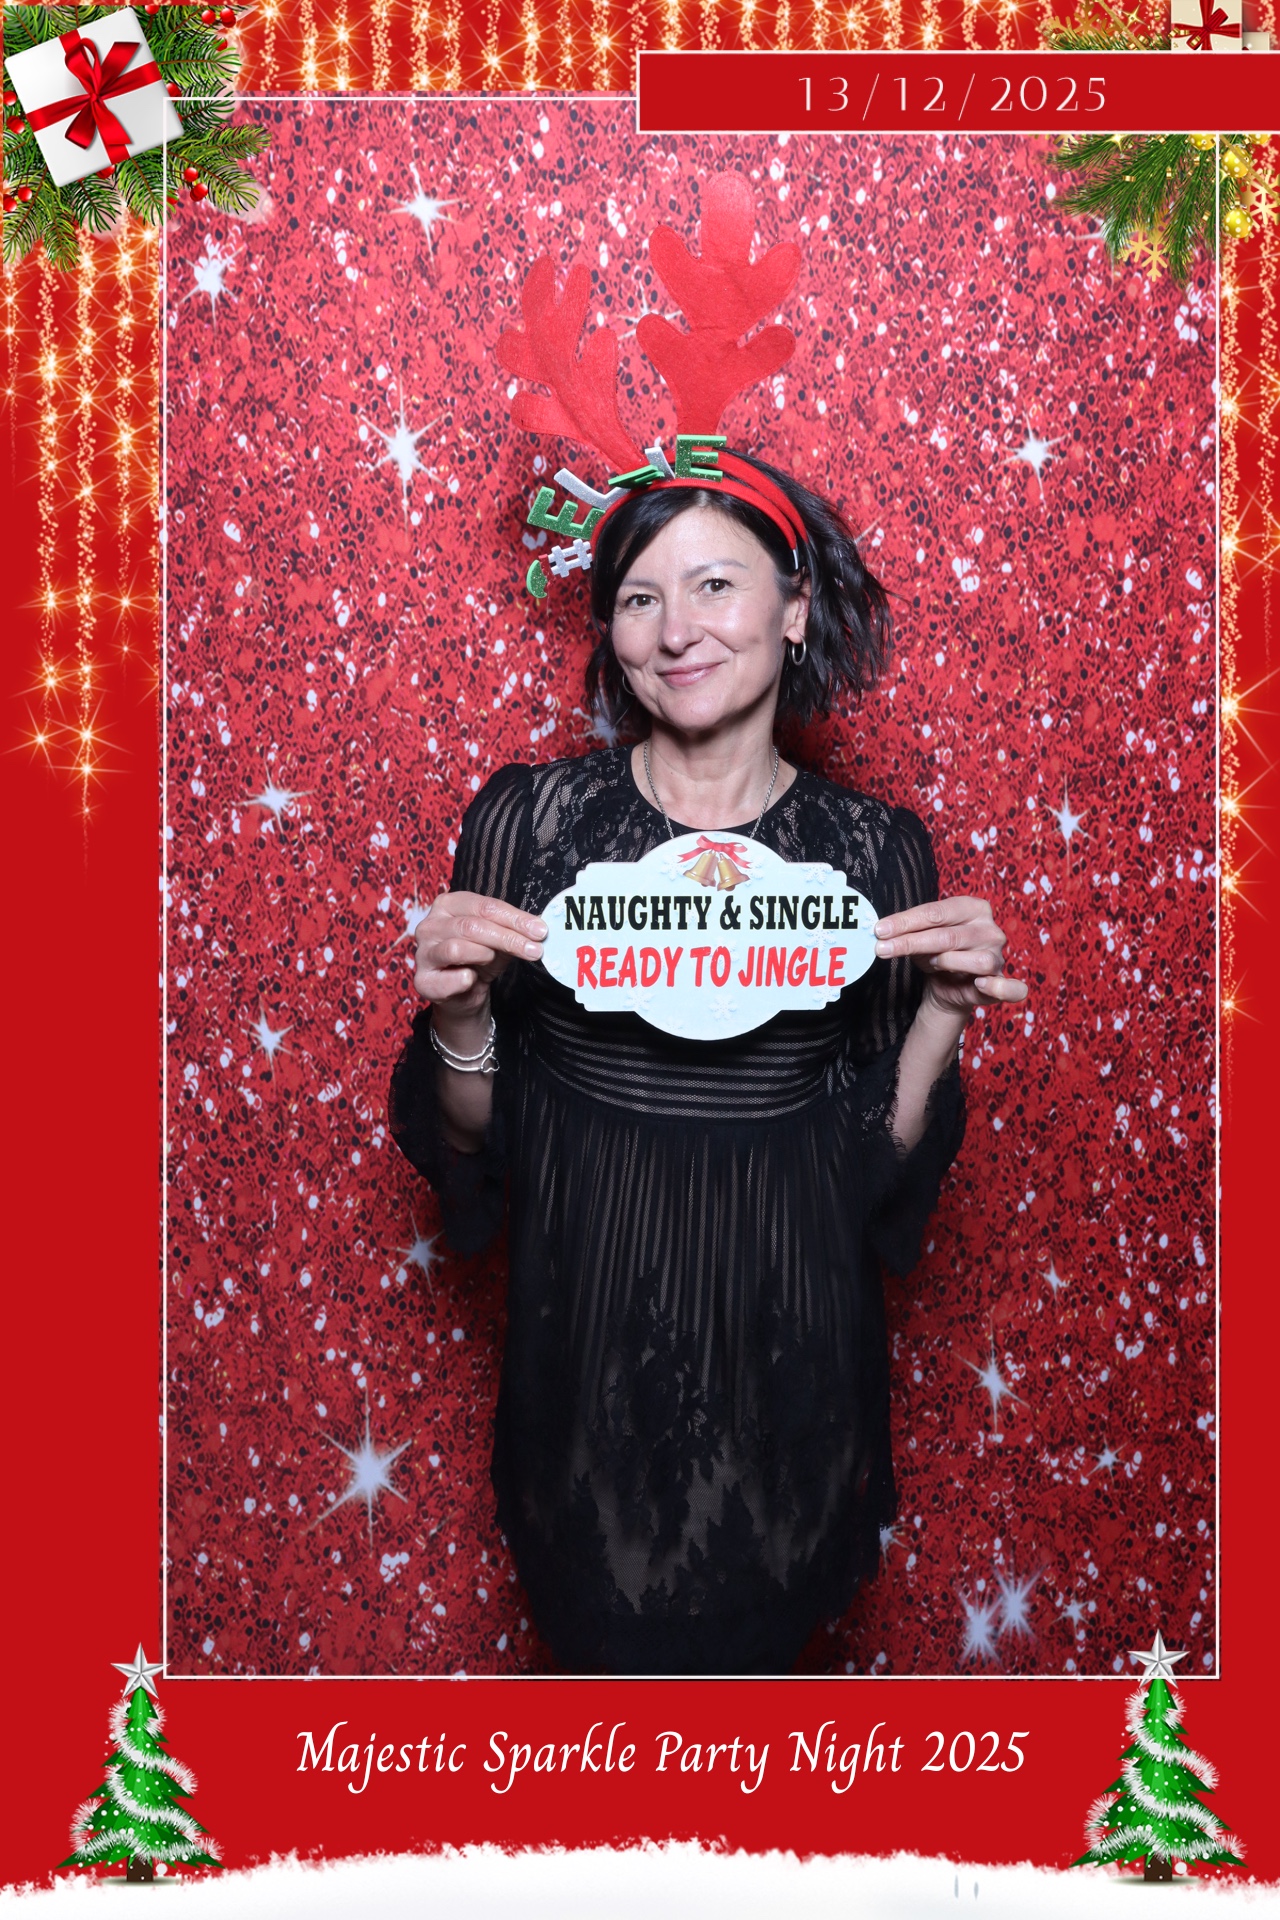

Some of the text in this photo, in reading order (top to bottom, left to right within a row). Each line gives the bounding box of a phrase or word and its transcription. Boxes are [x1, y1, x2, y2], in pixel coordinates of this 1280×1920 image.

[564, 895, 859, 931] NAUGHTY & SINGLE
[576, 945, 848, 989] READY TO JINGLE
